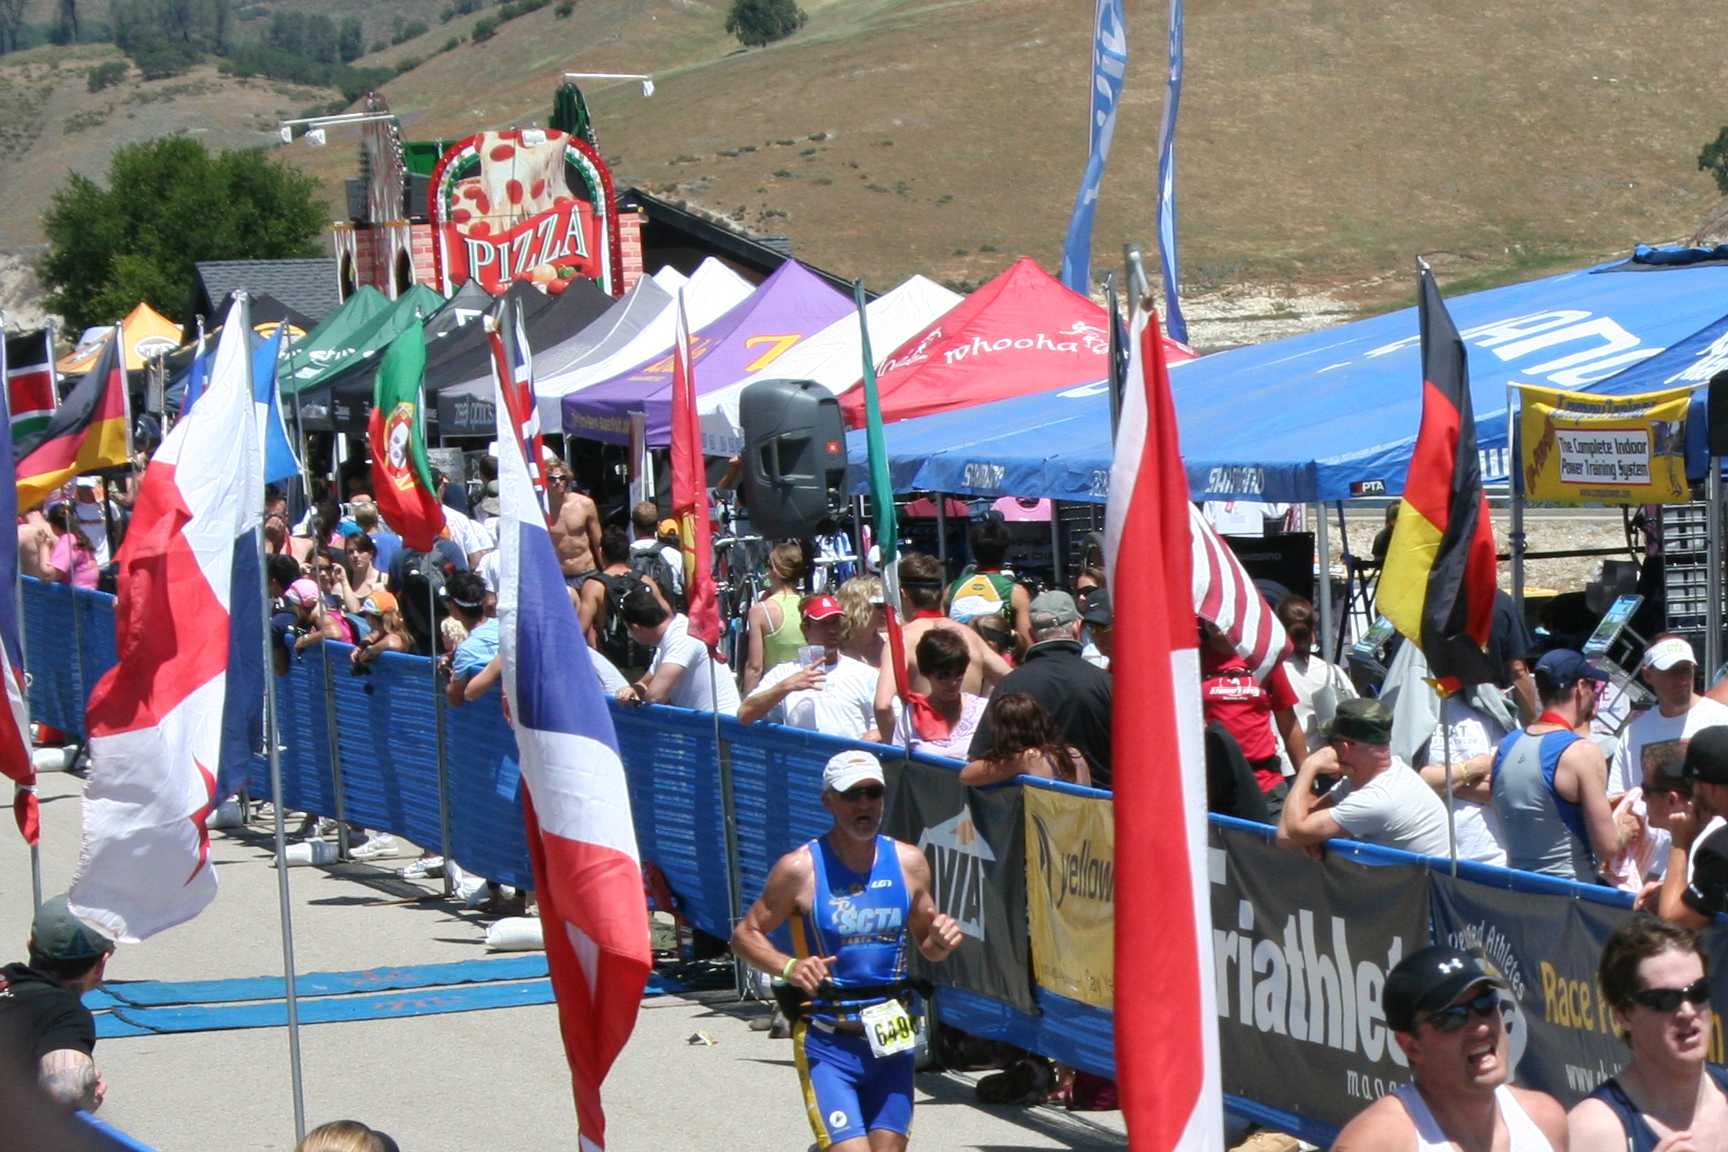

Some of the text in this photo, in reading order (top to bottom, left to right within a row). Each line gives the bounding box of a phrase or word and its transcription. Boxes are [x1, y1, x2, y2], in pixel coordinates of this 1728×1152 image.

[464, 204, 589, 286] PIZZA
[1558, 437, 1648, 457] The Complete Indoor
[1561, 458, 1649, 480] Power Training System
[1208, 847, 1410, 1068] riathlet
[1486, 925, 1525, 1001] Athletes
[1540, 960, 1595, 1031] Race
